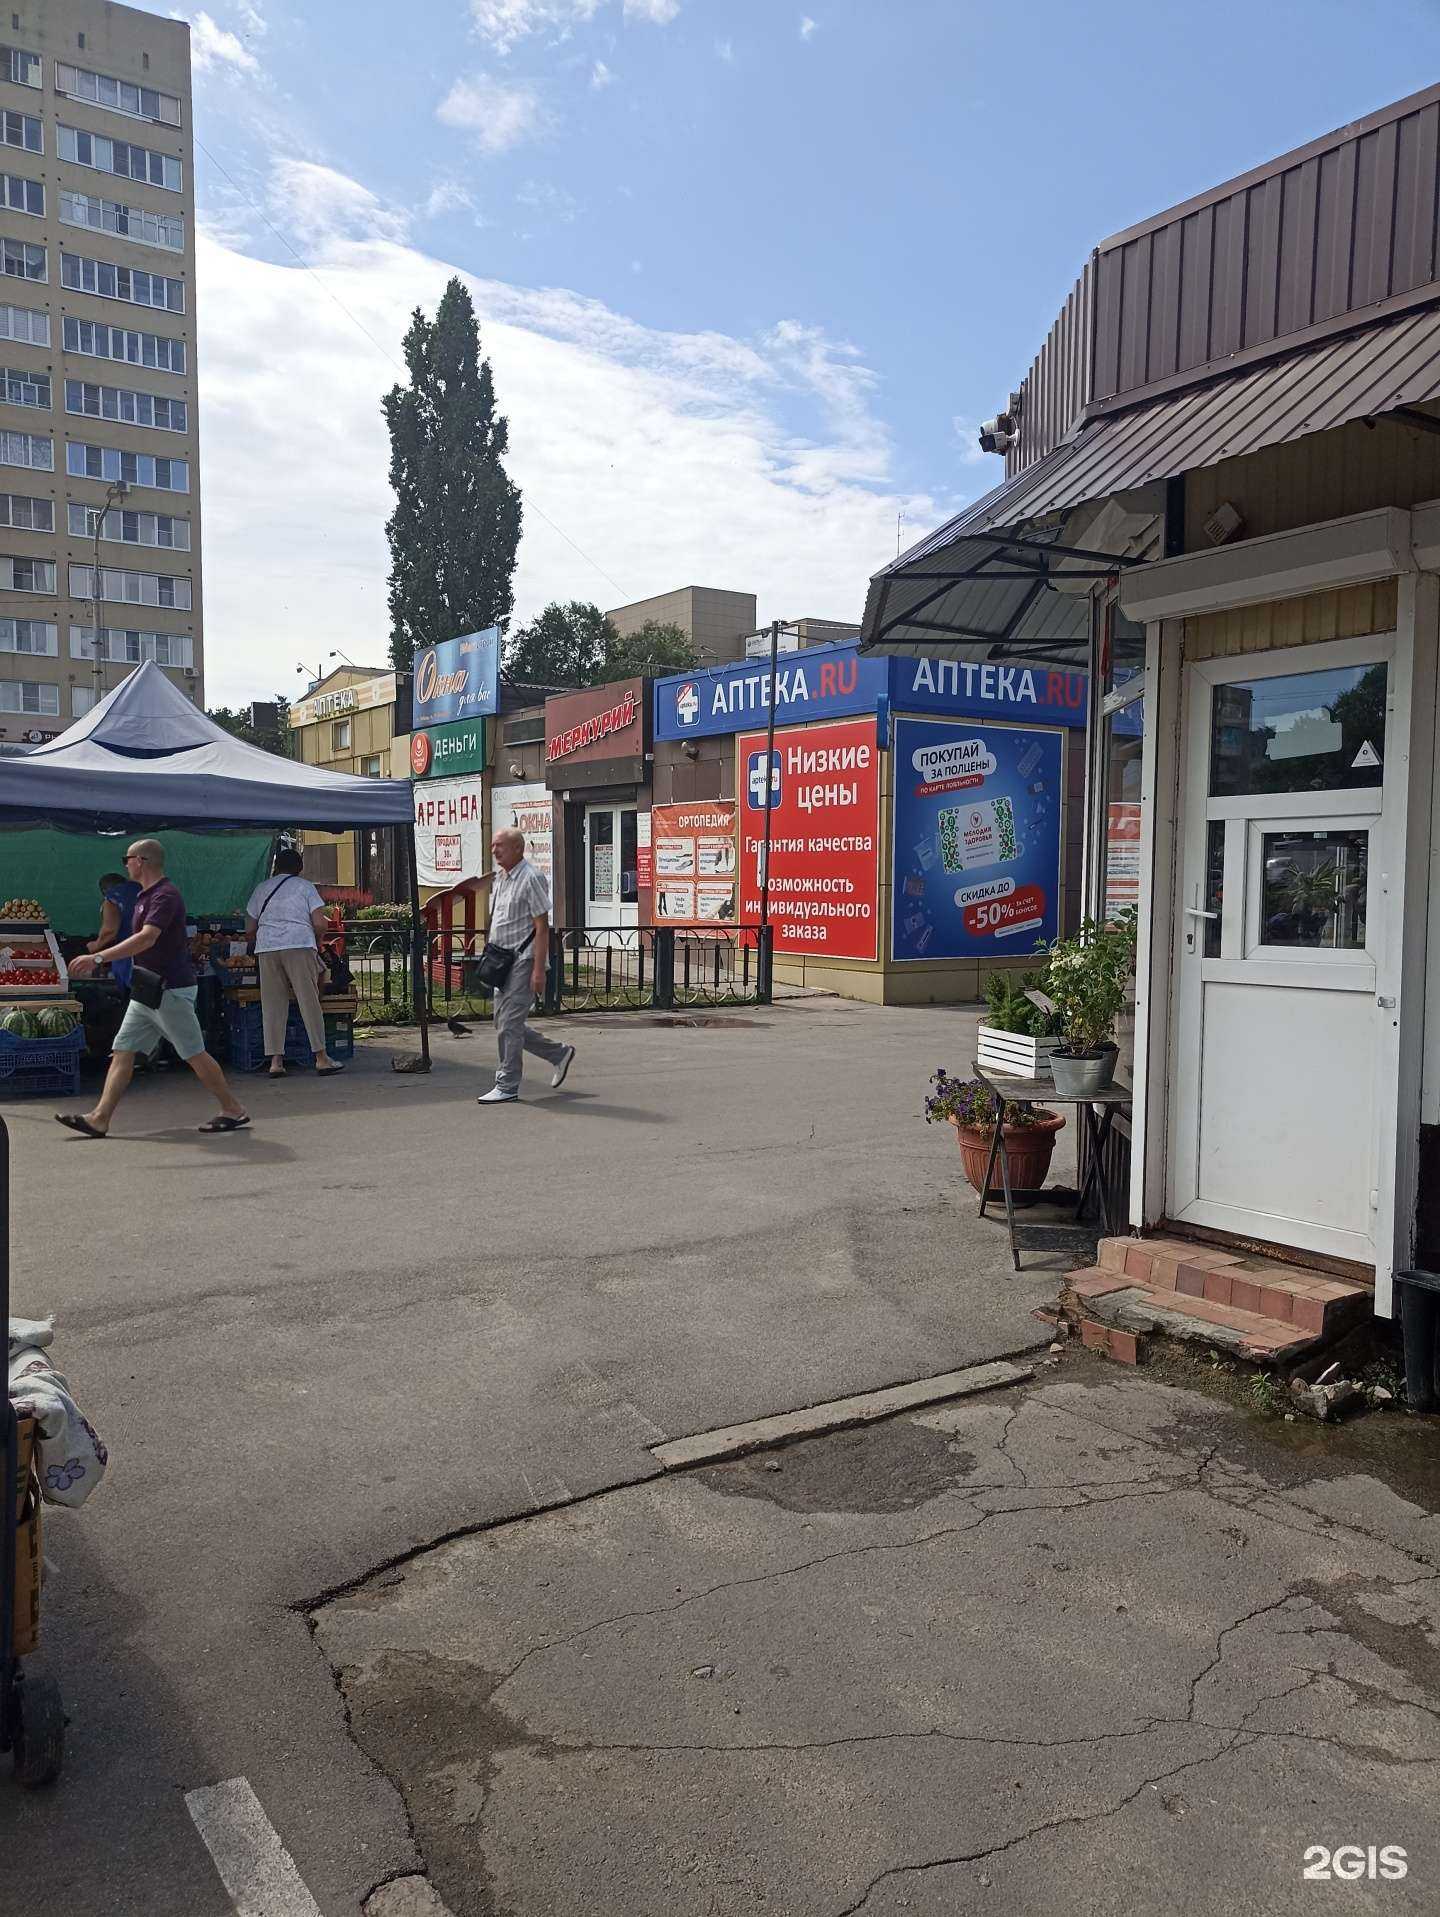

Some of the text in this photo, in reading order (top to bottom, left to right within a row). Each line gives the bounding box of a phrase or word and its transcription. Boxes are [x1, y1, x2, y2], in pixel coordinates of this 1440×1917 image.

[314, 690, 354, 717] АПТЕКА
[547, 690, 637, 761] МЕРКУРИЙ
[434, 733, 476, 759] ДЕНЬГИ
[920, 741, 979, 767] ПОКУПАЙ
[787, 745, 870, 775] Низкие
[931, 759, 990, 779] ЗА ПОЛЦЕНЫ
[797, 782, 858, 814] цены
[417, 794, 479, 827] АРЕНДА
[678, 813, 730, 828] ОРТОПЕДИЯ
[520, 812, 552, 832] ОКНА
[963, 826, 992, 837] МЕЛОДИЯ
[808, 836, 872, 852] качества
[760, 878, 854, 893] озможность
[960, 882, 1010, 903] СКИДКА ДО
[745, 900, 870, 920] инивидуального
[969, 901, 1014, 929] -50%
[781, 924, 827, 940] заказа
